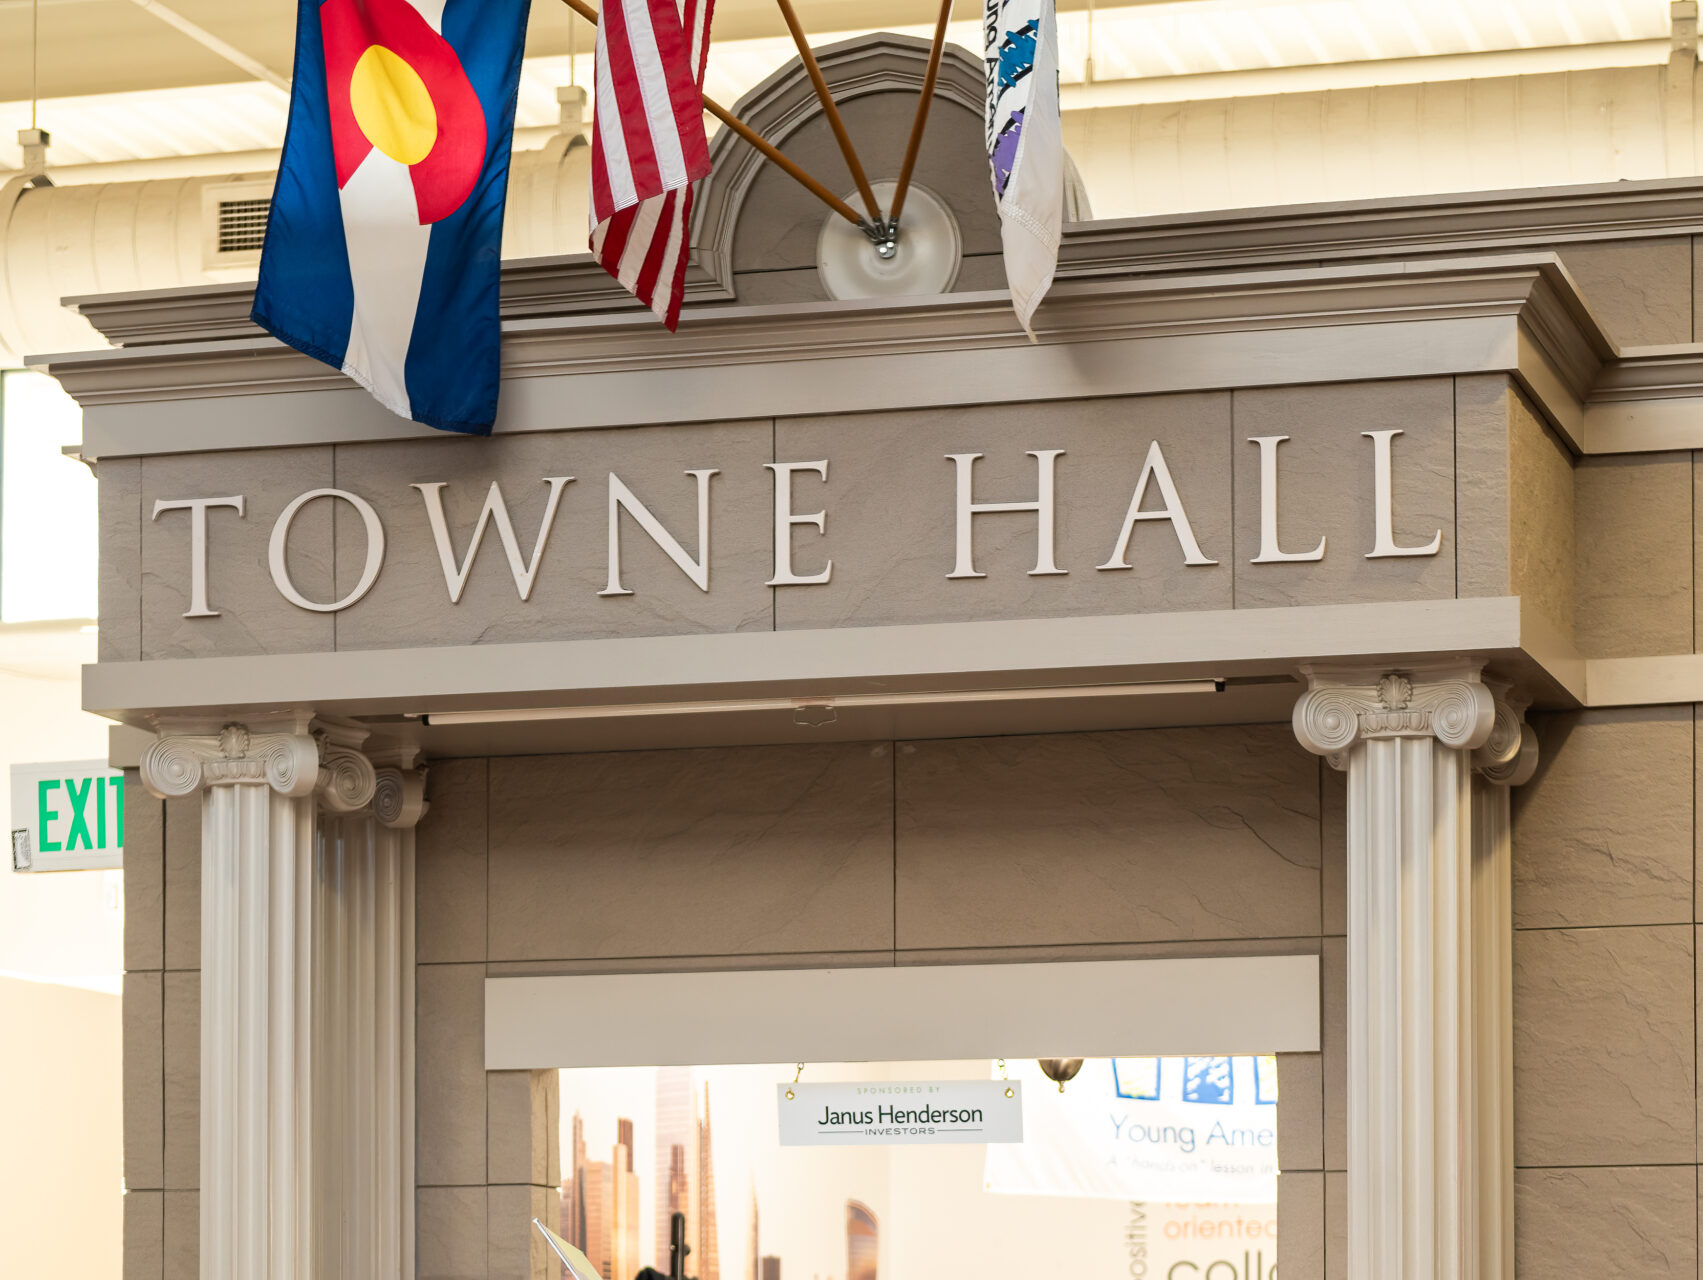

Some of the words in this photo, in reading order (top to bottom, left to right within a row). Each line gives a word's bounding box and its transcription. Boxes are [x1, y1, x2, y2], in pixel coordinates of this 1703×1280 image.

[151, 459, 834, 619] TOWNE
[944, 429, 1443, 579] HALL
[38, 776, 124, 852] EXIT
[857, 1087, 922, 1095] SPONSORED
[818, 1106, 873, 1125] Janus
[878, 1104, 983, 1124] Henderson
[1110, 1114, 1196, 1153] Young
[1206, 1121, 1274, 1146] Ame
